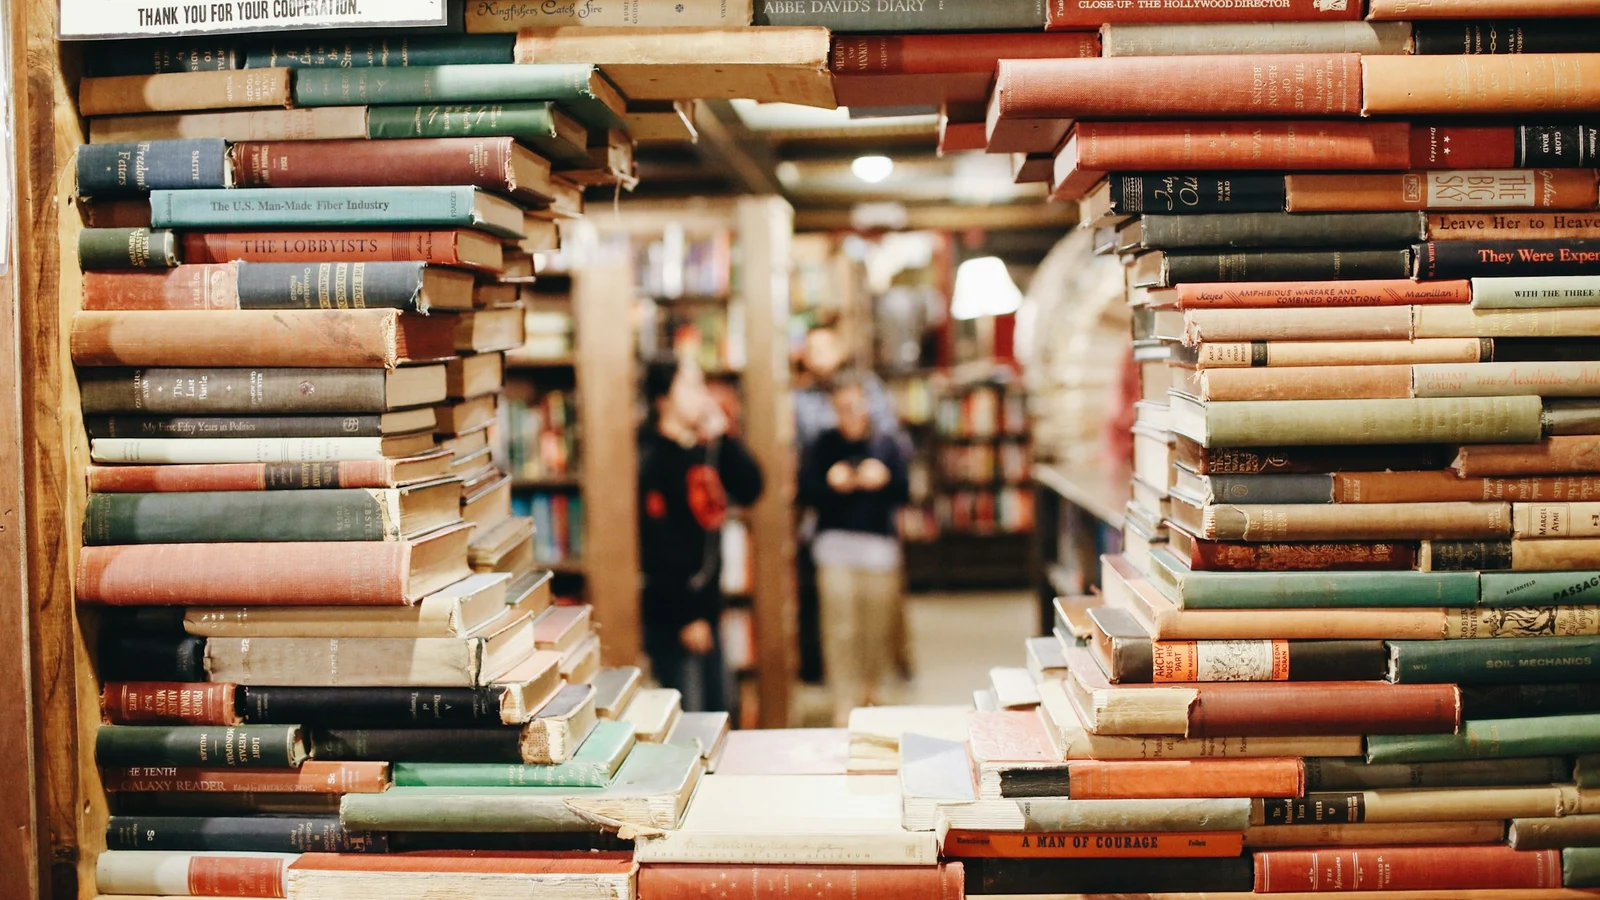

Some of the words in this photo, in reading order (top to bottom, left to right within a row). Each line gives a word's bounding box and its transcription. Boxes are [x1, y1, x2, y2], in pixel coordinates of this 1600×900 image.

[137, 7, 179, 26] THANK
[183, 5, 207, 24] YOU
[210, 3, 233, 22] FOR
[238, 1, 269, 21] YOUR
[273, 0, 362, 18] COOPERATION.
[477, 1, 538, 21] Kingfishers
[541, 0, 576, 16] Catch
[577, 0, 603, 18] Fire
[811, 0, 871, 14] DAVID'S
[877, 0, 927, 12] DIARY
[1138, 0, 1162, 9] THE
[1164, 0, 1234, 9] HOLLYWOOD
[1234, 0, 1291, 9] DIRECTOR
[1295, 63, 1304, 87] THE
[1253, 67, 1262, 105] BEGINS
[1268, 65, 1277, 106] REASON
[1282, 78, 1291, 93] OF
[1315, 69, 1323, 101] DURANT
[1295, 88, 1304, 108] AGE
[1554, 131, 1562, 157] GLORY
[118, 150, 131, 186] Fetters
[1435, 175, 1464, 202] SKY
[1467, 175, 1495, 201] BIG
[1499, 174, 1527, 200] THE
[1539, 169, 1558, 207] Guthrie
[210, 200, 230, 211] The
[233, 200, 255, 211] U.S.
[258, 200, 312, 211] Man-Made
[317, 199, 345, 211] Fiber
[346, 199, 390, 212] Industry
[1439, 216, 1485, 230] Leave
[1493, 216, 1521, 229] Her
[1529, 218, 1545, 229] to
[1553, 215, 1600, 229] Heave
[241, 239, 277, 254] THE
[284, 239, 378, 254] LOBBYISTS
[1478, 249, 1514, 264] They
[1517, 249, 1554, 262] Were
[336, 266, 346, 280] AND
[354, 265, 363, 280] THE
[1196, 292, 1224, 303] Keyes
[1238, 289, 1292, 297] AMPHIBIOUS
[1295, 288, 1335, 296] WARFARE
[1337, 288, 1357, 296] AND
[1276, 296, 1322, 304] COMBINED
[1326, 295, 1382, 304] OPERATIONS
[1405, 289, 1453, 299] Macmillan
[1514, 290, 1538, 298] WITH
[1542, 289, 1560, 297] THE
[1563, 289, 1595, 297] THREE
[173, 378, 183, 397] The
[186, 379, 195, 398] Last
[199, 375, 208, 400] Battle
[177, 421, 196, 433] Fifty
[198, 421, 218, 432] Years
[220, 421, 228, 431] in
[1539, 508, 1547, 536] MARCEL
[1506, 580, 1537, 596] ROSENFELD
[1553, 575, 1600, 600] PASSAG
[1486, 660, 1515, 669] SOIL
[1518, 657, 1592, 667] MECHANICS
[129, 692, 137, 711] DIETZ
[156, 689, 166, 716] MENTS
[181, 689, 191, 716] SIONAL
[226, 728, 235, 766] MONOPOLY
[239, 732, 247, 763] METALS
[252, 736, 260, 759] LIGHT
[143, 767, 177, 777] TENTH
[121, 780, 173, 791] GALAXY
[176, 780, 226, 791] READER
[1273, 806, 1281, 818] The
[1297, 803, 1305, 819] Years
[147, 829, 155, 841] Sc
[1021, 837, 1030, 848] A
[1037, 837, 1066, 848] MAN
[1072, 837, 1089, 848] OF
[1096, 836, 1158, 849] COURAGE
